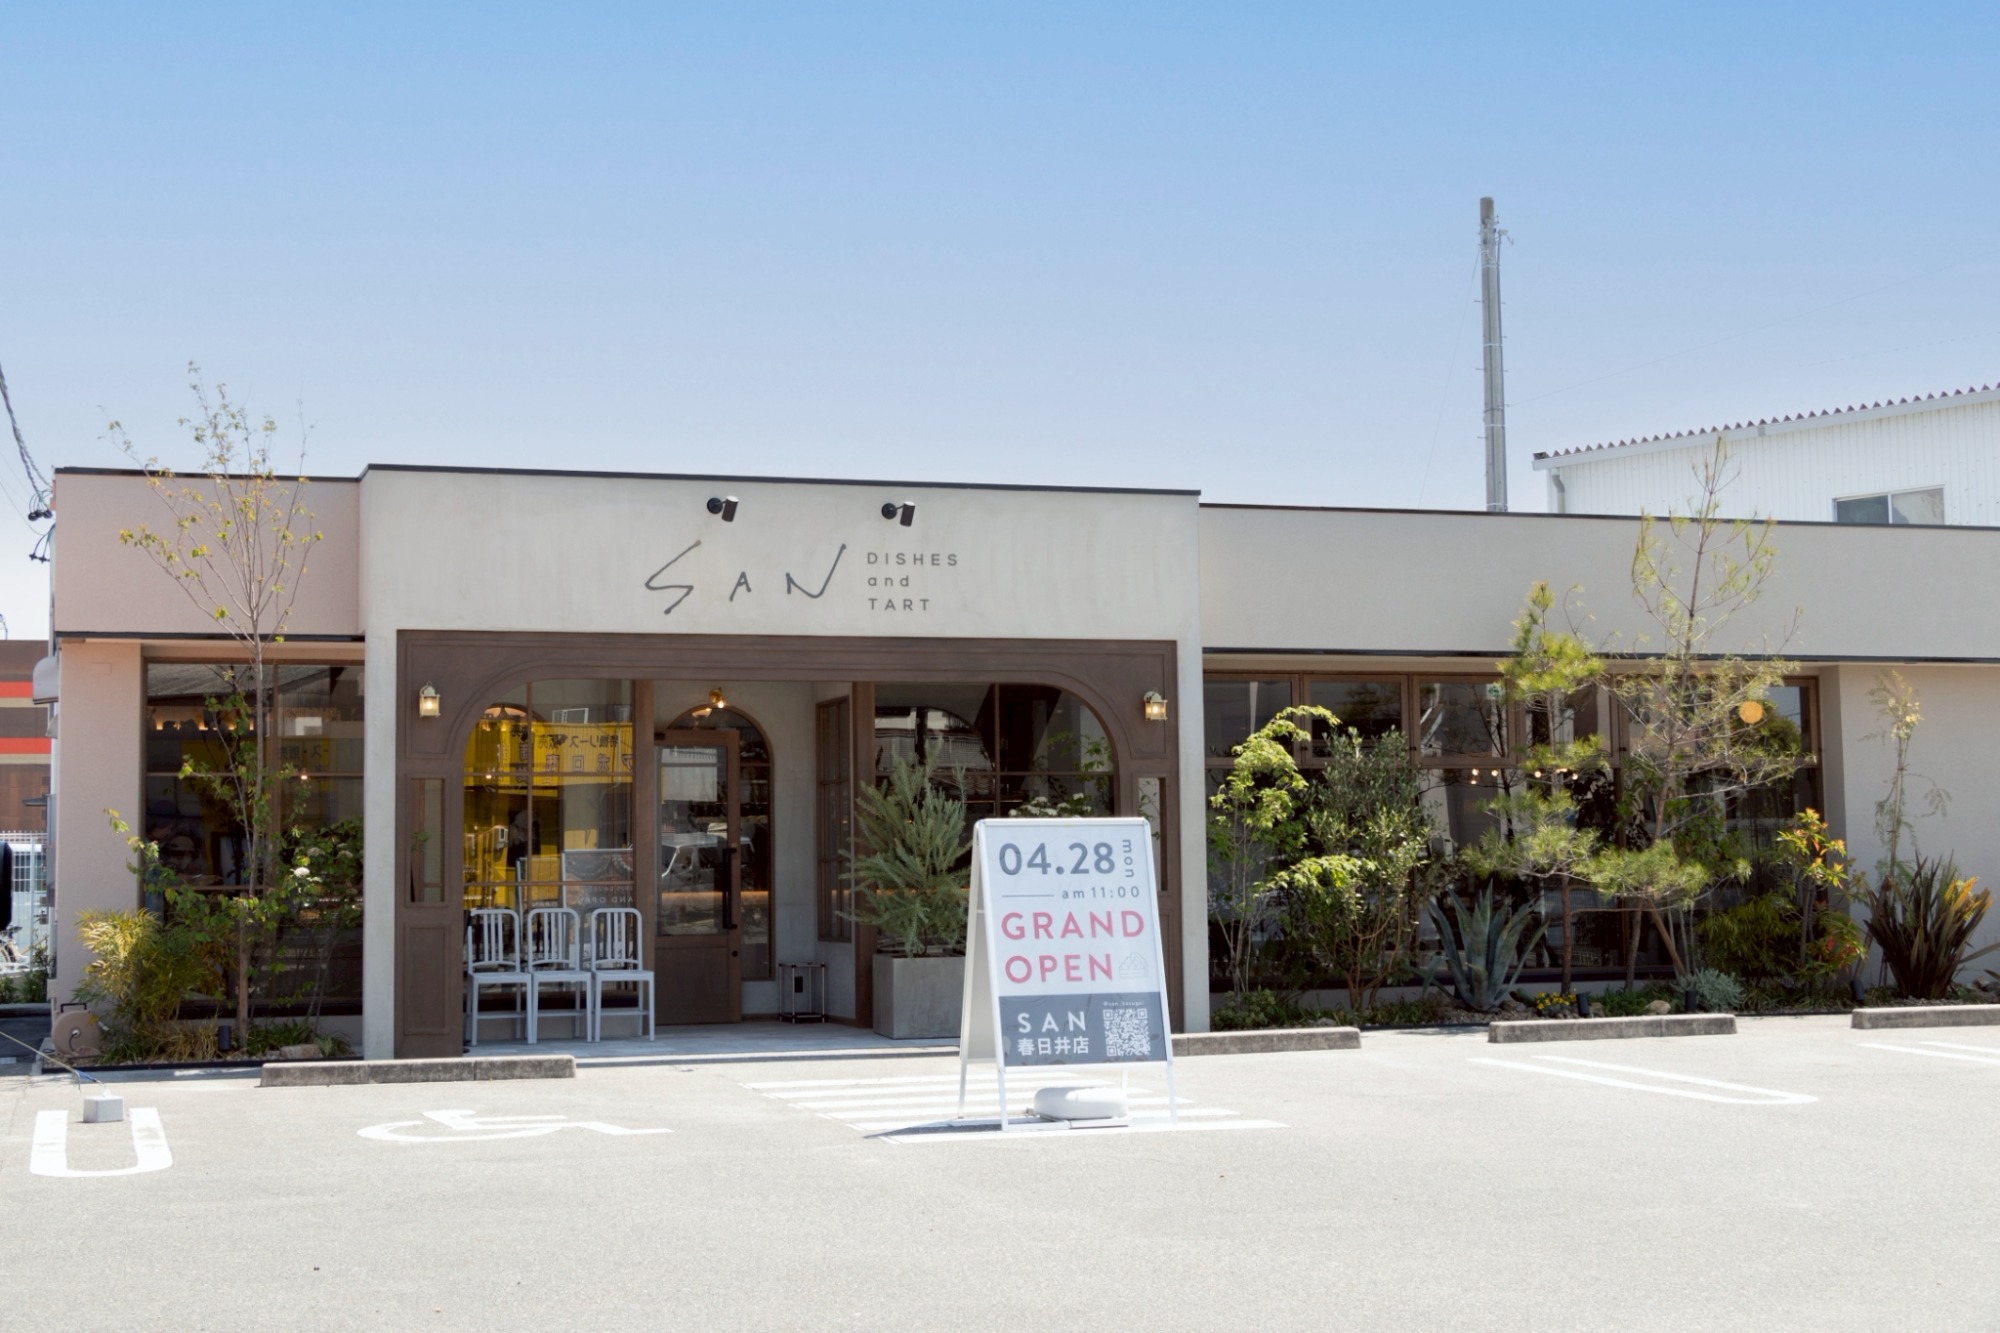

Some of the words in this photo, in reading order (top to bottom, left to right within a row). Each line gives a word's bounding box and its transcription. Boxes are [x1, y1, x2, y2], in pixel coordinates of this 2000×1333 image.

[867, 552, 958, 567] DISHES
[645, 540, 847, 615] SAN
[867, 575, 910, 588] and
[868, 598, 930, 612] TART
[999, 842, 1116, 876] 04.28
[1122, 839, 1135, 878] mon
[1001, 910, 1145, 940] GRAND
[1005, 953, 1114, 983] OPEN
[1017, 1011, 1086, 1033] SAN
[1017, 1036, 1089, 1056] 春日井店
